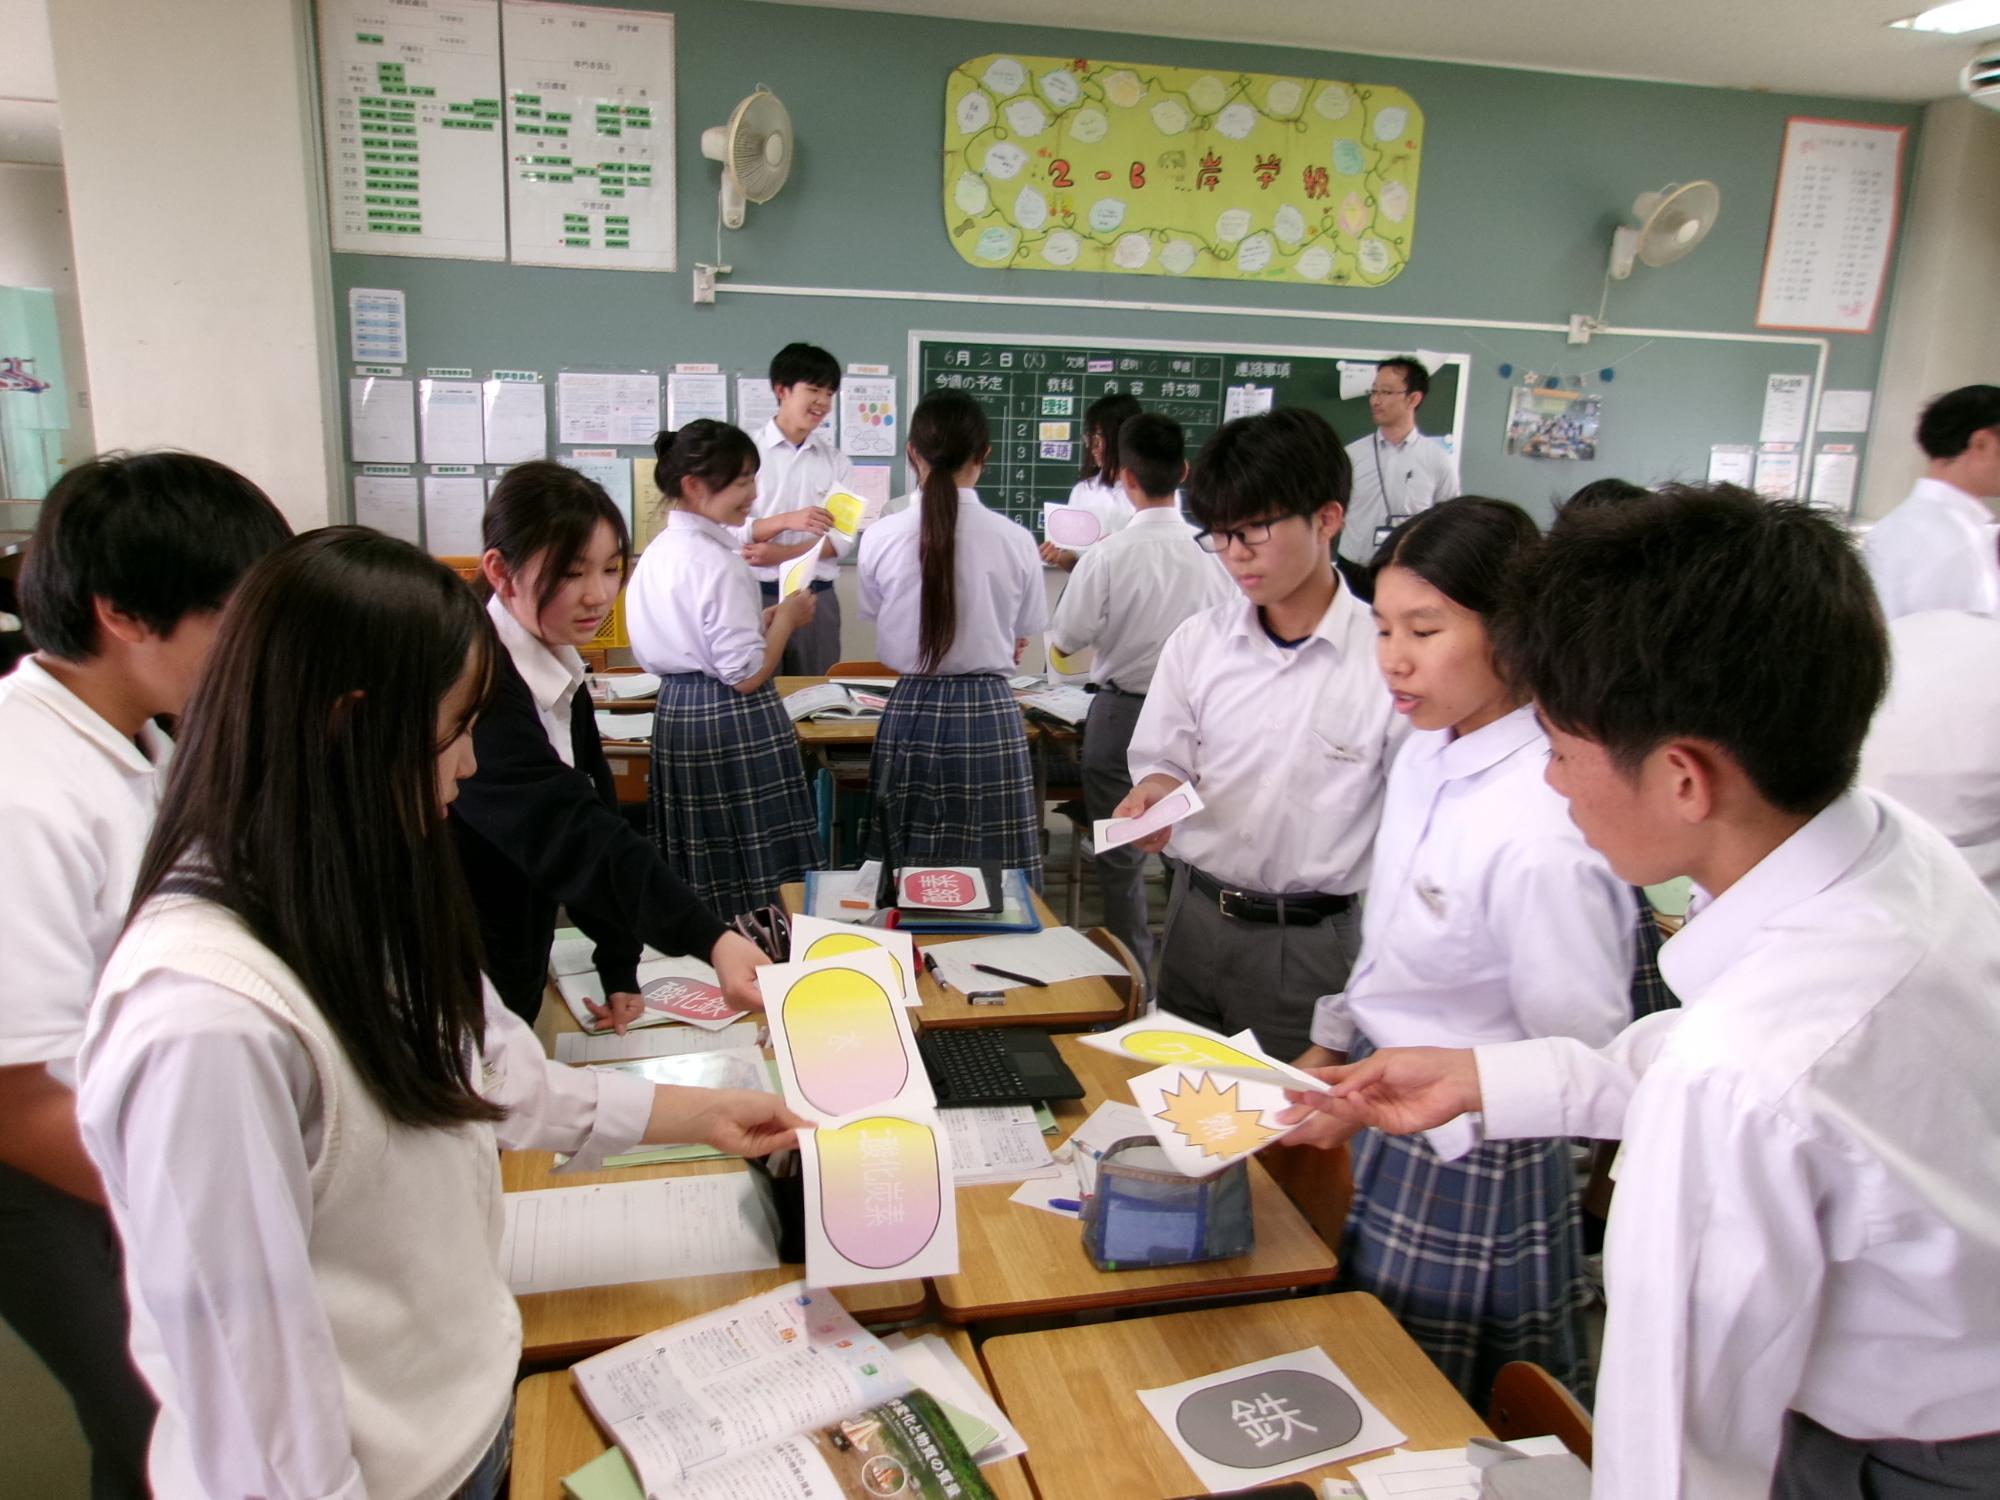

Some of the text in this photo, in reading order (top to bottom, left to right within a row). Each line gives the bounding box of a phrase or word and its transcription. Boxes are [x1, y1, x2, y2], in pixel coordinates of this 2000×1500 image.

[1234, 361, 1291, 379] 連絡事項
[934, 373, 1003, 392] 今週の予定
[1046, 378, 1074, 393] 教科
[1161, 382, 1200, 398] 持ち物
[1043, 398, 1070, 414] 理科
[1016, 423, 1027, 437] 2
[1016, 446, 1026, 459] 3
[1042, 443, 1069, 458] 英語
[1015, 469, 1025, 481] 4
[1015, 491, 1025, 504] 5
[921, 872, 962, 903] 酸素
[653, 980, 728, 1018] 酸化鉄
[857, 1127, 905, 1228] 二酸化炭素
[1231, 1392, 1318, 1448] 鉄
